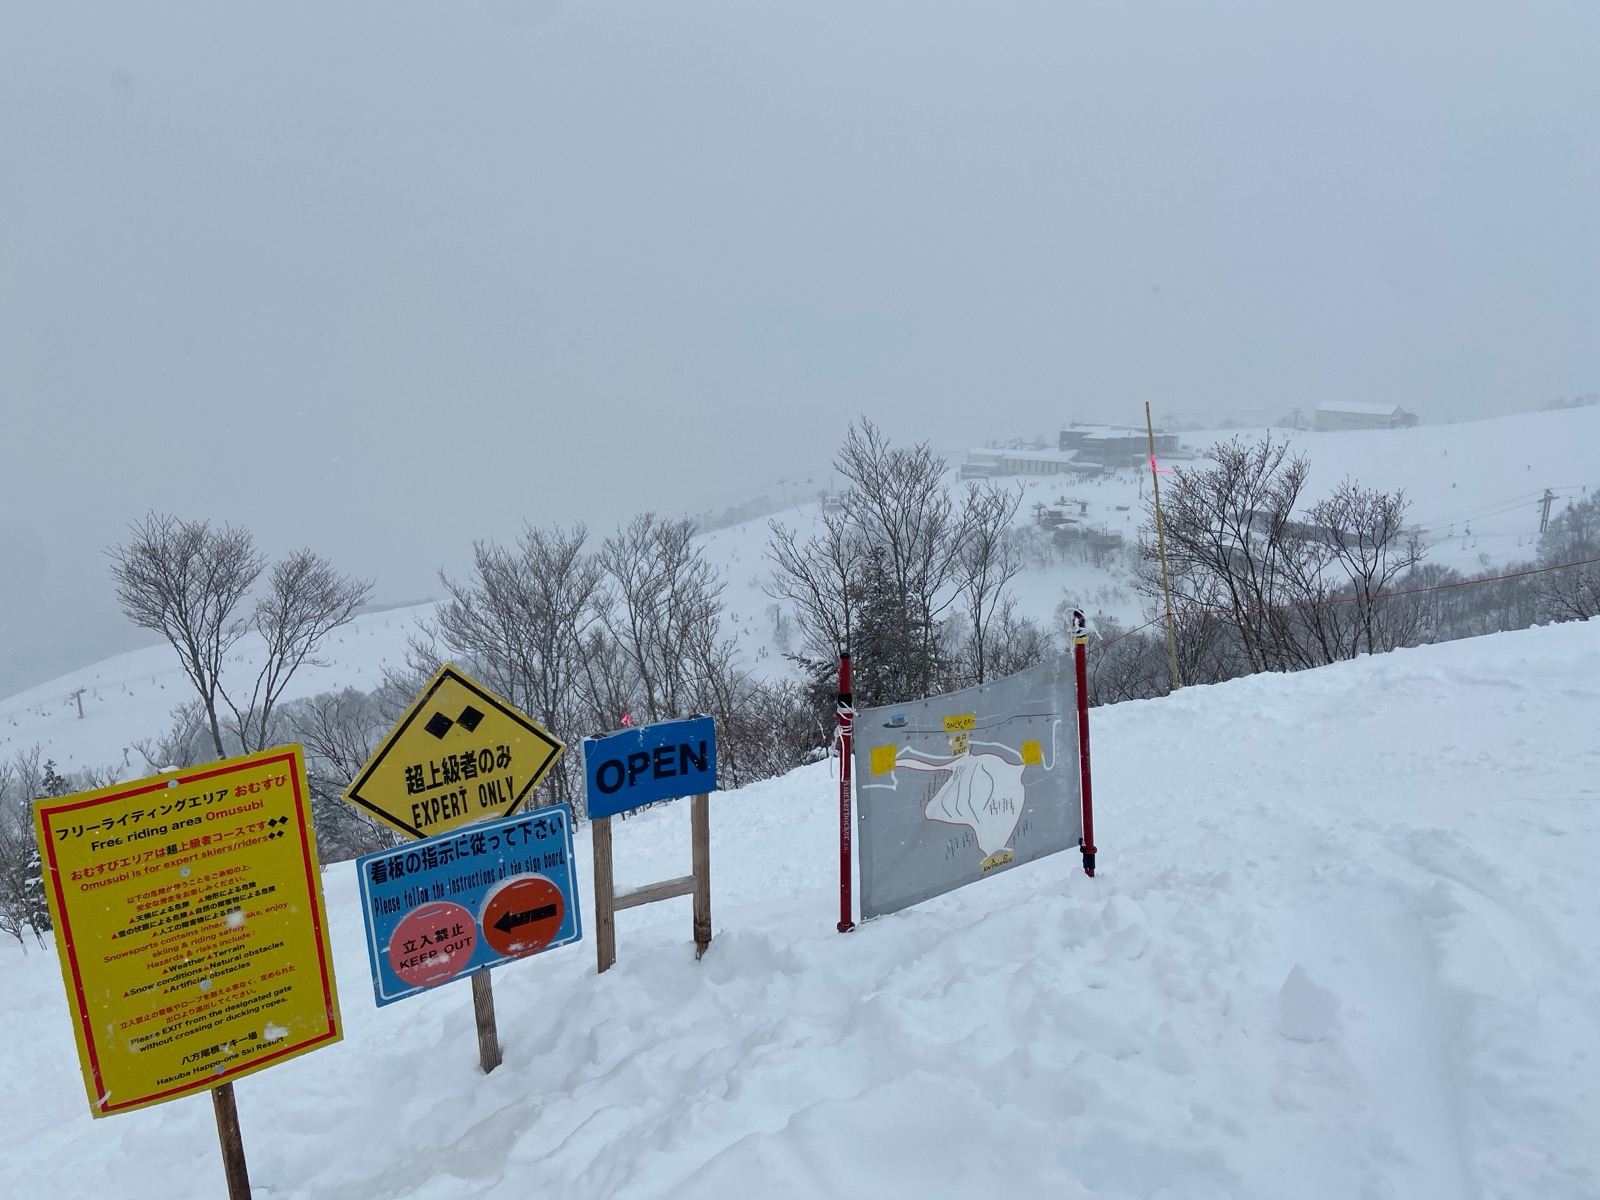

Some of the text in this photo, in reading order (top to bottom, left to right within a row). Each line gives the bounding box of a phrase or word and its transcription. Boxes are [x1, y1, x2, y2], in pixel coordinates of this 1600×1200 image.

[405, 745, 512, 795] 超上級者のみ
[596, 741, 707, 794] OPEN
[953, 746, 967, 756] EXIT
[55, 774, 286, 840] フリーライディングエリア おむすび
[90, 798, 263, 851] Free riding area Omusubi
[412, 776, 514, 829] EXPERT ONLY
[843, 779, 851, 841] Knickerbocker
[80, 871, 129, 891] Omusubi
[143, 864, 160, 873] for
[163, 853, 198, 868] expert
[371, 816, 564, 885] 看板の指示に従って下さい
[983, 856, 1014, 872] ENTRANCE
[373, 896, 400, 917] Please
[403, 886, 429, 907] follow
[432, 879, 445, 899] the
[448, 869, 496, 895] instructions
[499, 861, 507, 880] of
[511, 856, 522, 878] the
[525, 852, 541, 875] sign
[103, 942, 158, 963] Snowsports
[160, 929, 198, 945] contains
[264, 902, 287, 912] enjoy
[146, 953, 184, 969] Hazards
[195, 943, 217, 953] risks
[151, 945, 179, 957] skiing
[190, 933, 216, 945] riding
[400, 936, 472, 970] KEEP OUT
[402, 923, 465, 955] 立入禁止
[129, 941, 284, 995] Snow conditions Natural obstacles
[168, 944, 245, 972] Weather Terrain
[169, 961, 250, 992] Artificial obstacles
[139, 1036, 173, 1052] without
[174, 1022, 212, 1039] crossing
[225, 1006, 259, 1021] ducking
[261, 997, 287, 1009] ropes.
[161, 1022, 182, 1034] EXIT
[184, 1015, 206, 1026] from
[208, 1009, 222, 1017] the
[224, 991, 271, 1012] designated
[273, 985, 291, 996] gate
[156, 1071, 190, 1085] Hakuba
[192, 1053, 239, 1073] Happo-one
[241, 1046, 254, 1055] Ski
